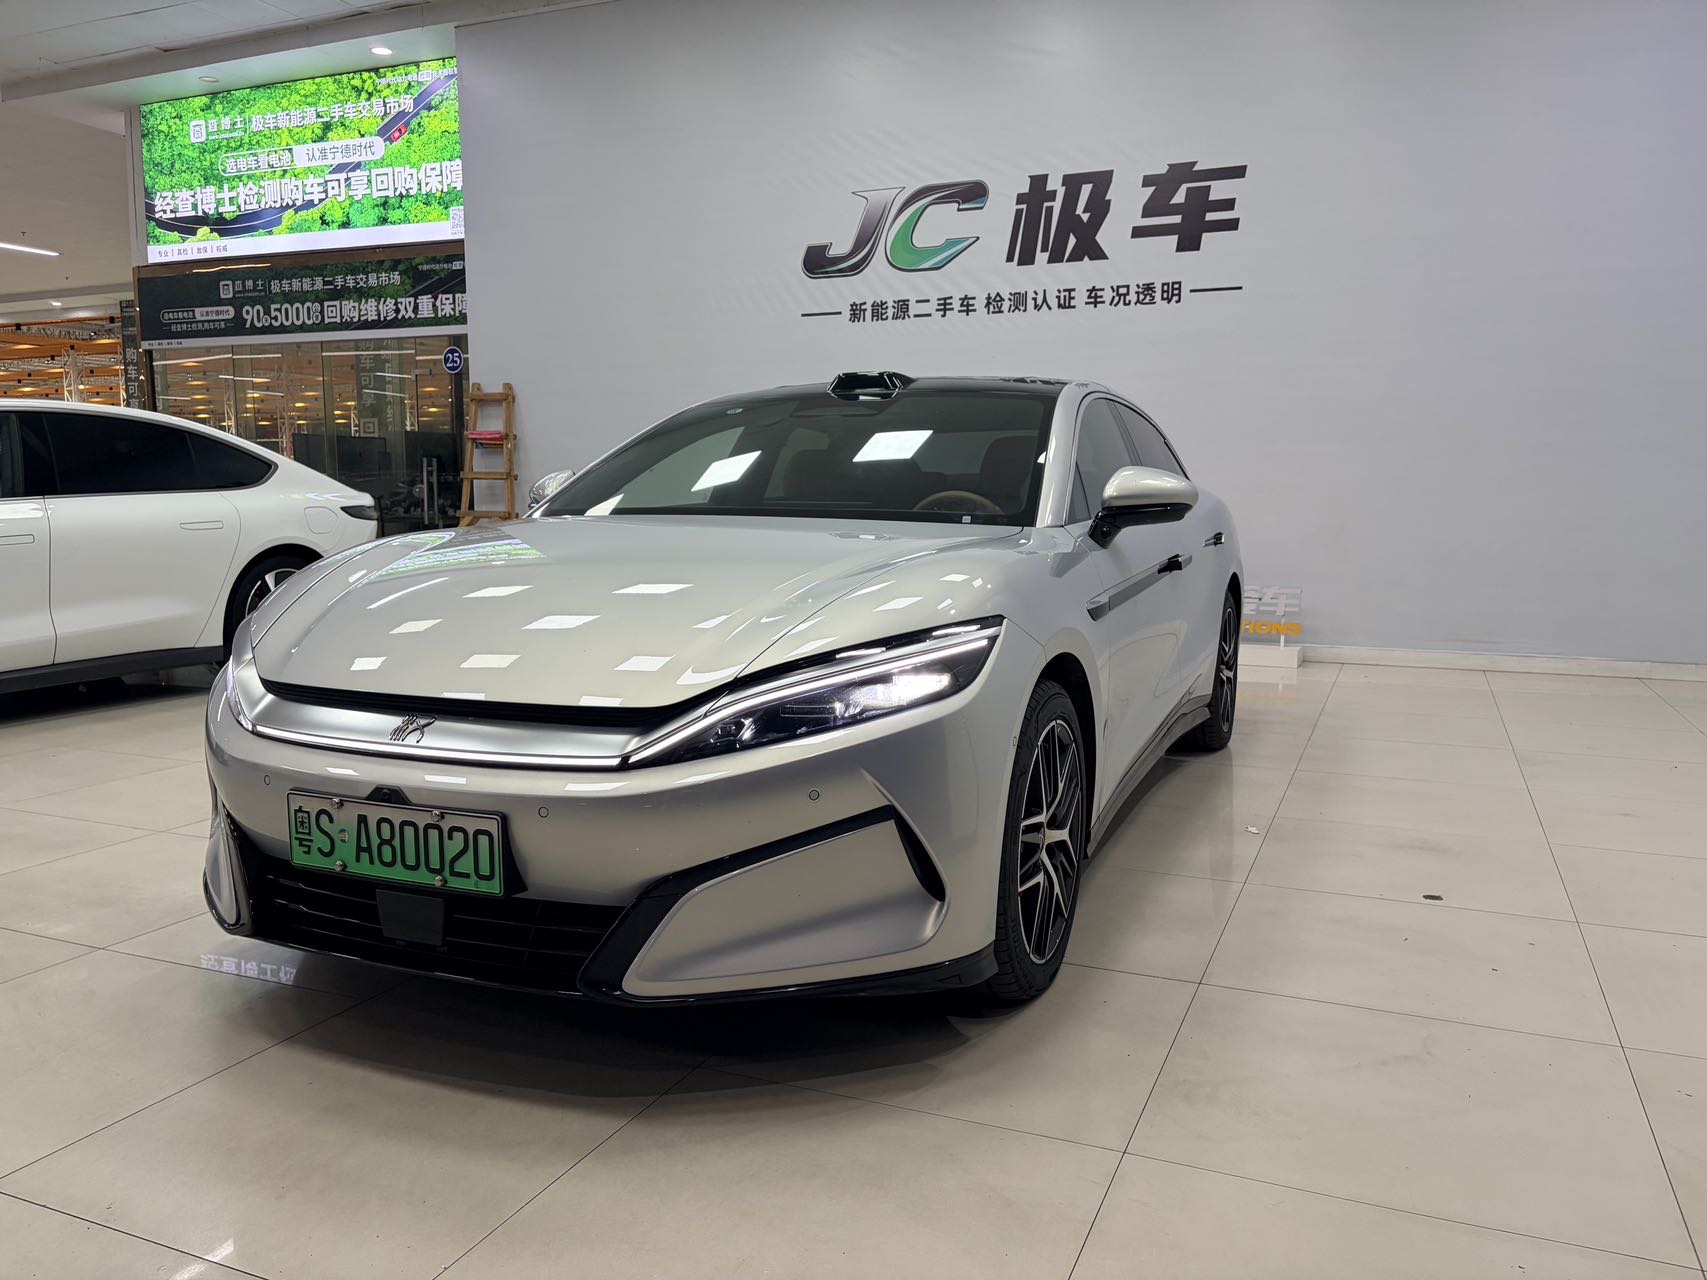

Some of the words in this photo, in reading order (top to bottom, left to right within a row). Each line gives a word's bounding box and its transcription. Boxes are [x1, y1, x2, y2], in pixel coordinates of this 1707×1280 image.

[251, 95, 414, 132] 极车新能源二手车交易市场
[226, 150, 292, 174] 选电车看电池
[305, 140, 376, 162] 认准宁德时代
[153, 159, 465, 219] 经查博士检测购车可享回购保障
[801, 179, 990, 279] JC
[1005, 161, 1248, 266] 极车
[270, 271, 401, 293] 极车新能源二手车交易市场
[848, 294, 978, 323] 新能源二手车
[984, 287, 1077, 315] 检测认证
[1084, 281, 1183, 309] 车况透明
[446, 352, 460, 367] 25
[355, 814, 496, 881] A80020
